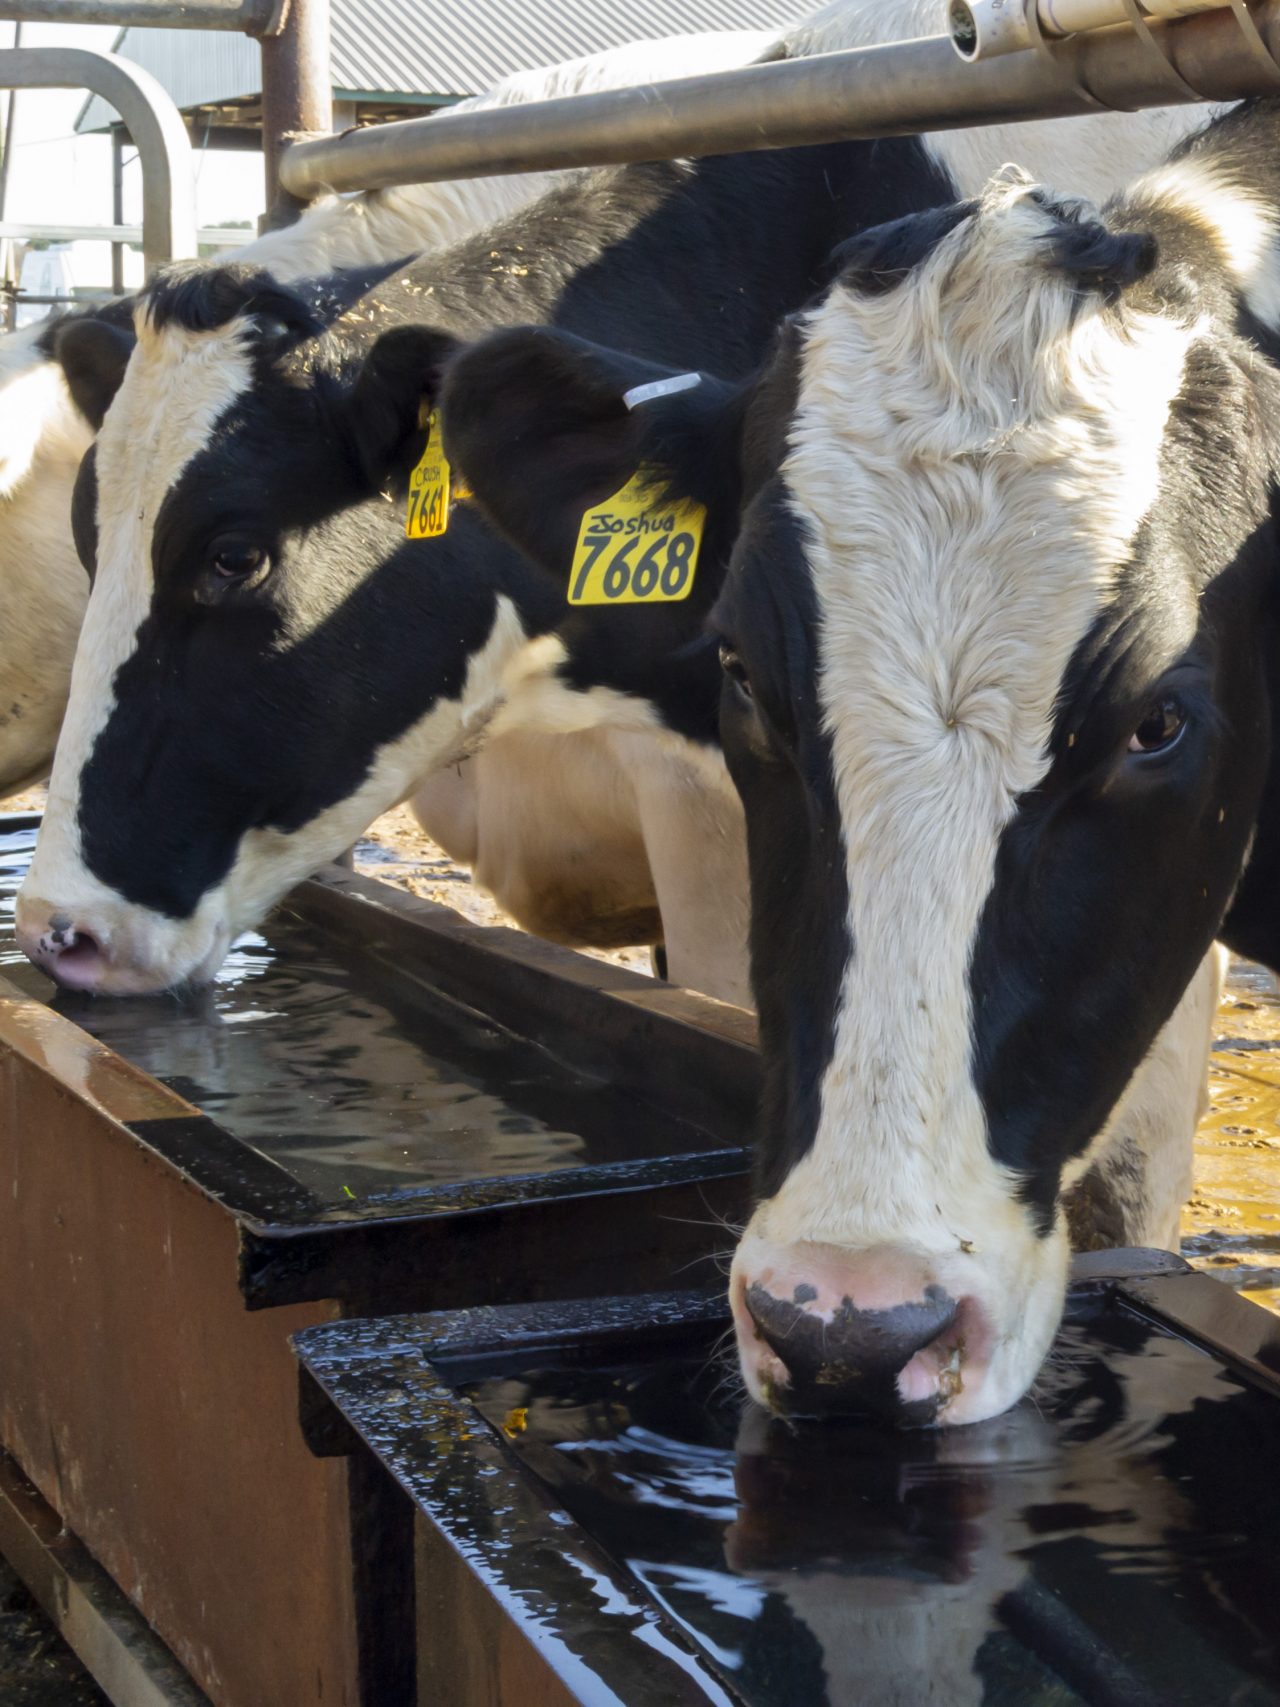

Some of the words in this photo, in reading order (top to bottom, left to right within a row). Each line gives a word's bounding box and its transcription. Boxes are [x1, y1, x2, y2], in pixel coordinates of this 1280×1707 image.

[408, 485, 444, 536] 7661
[587, 511, 676, 535] Joshua
[571, 532, 695, 601] 7668
